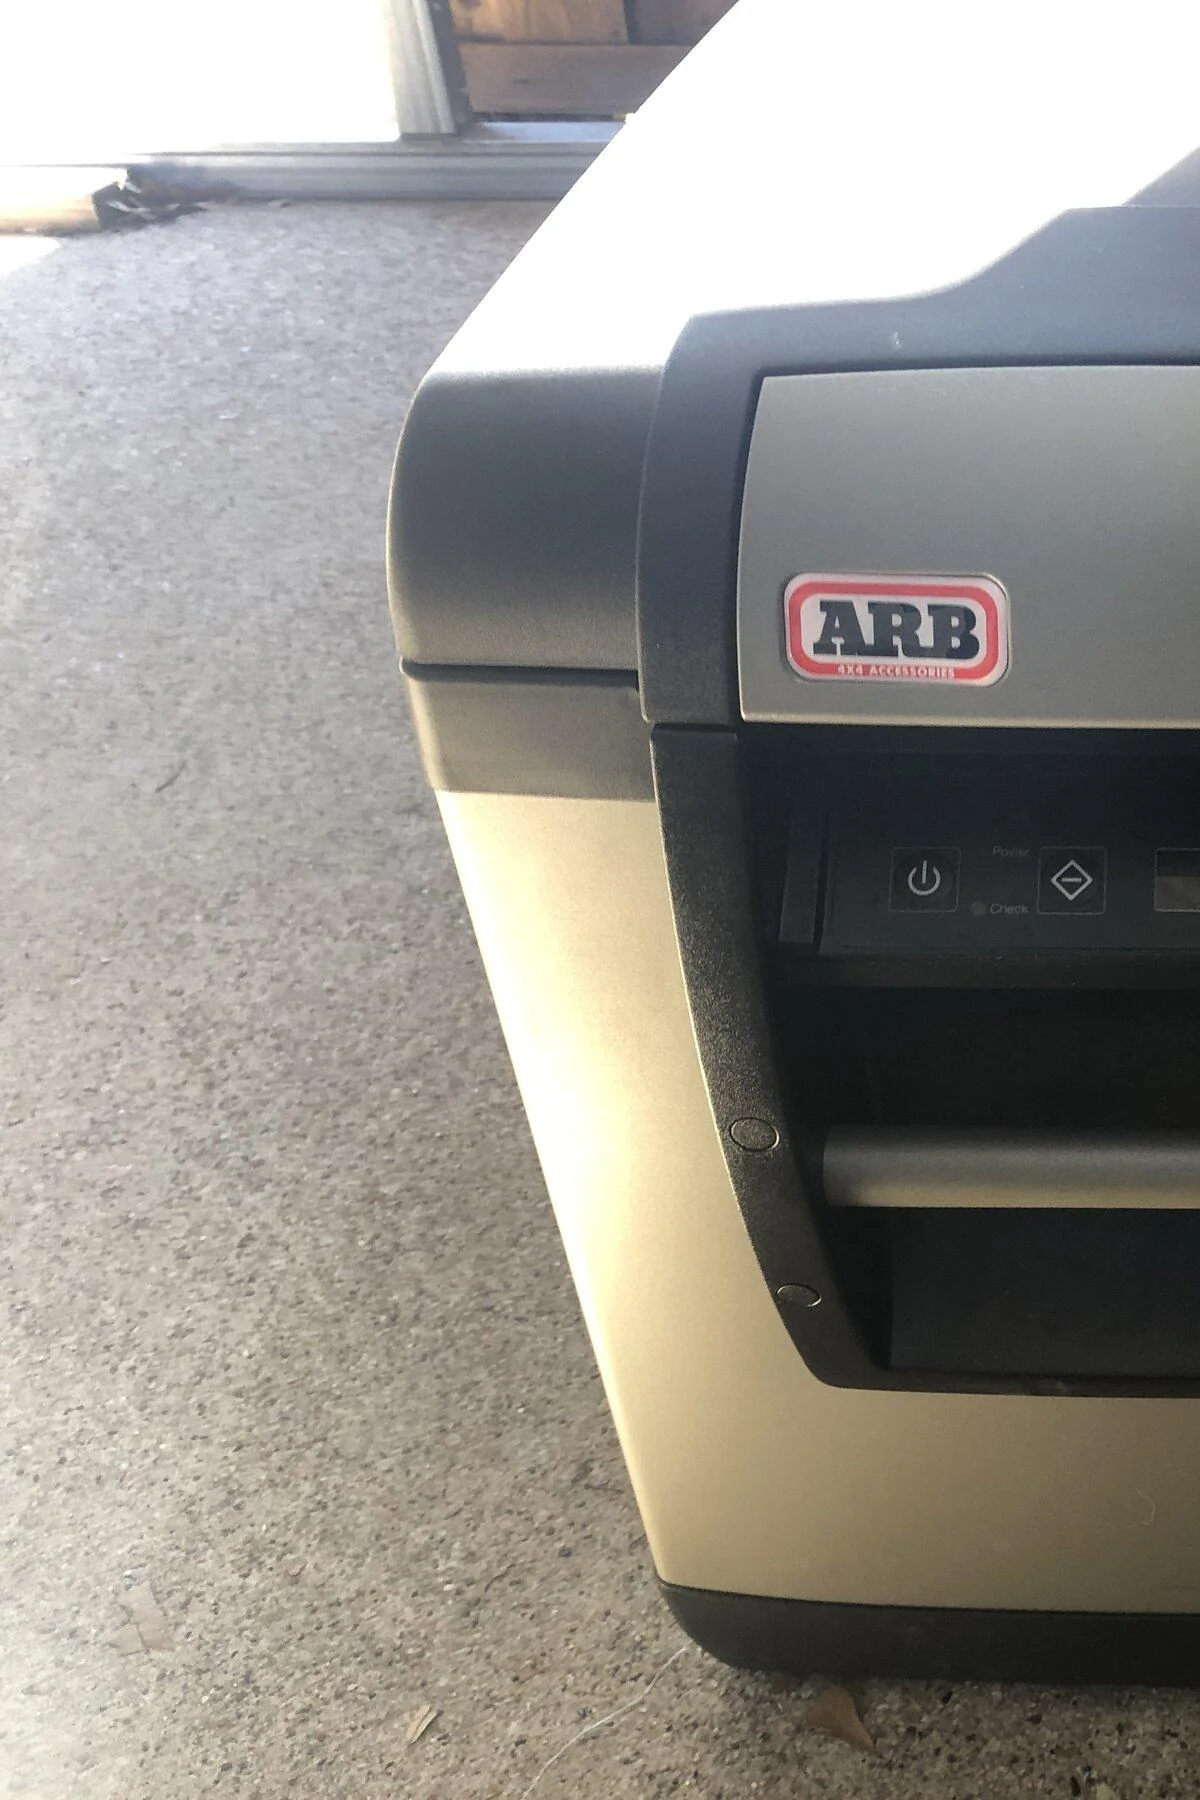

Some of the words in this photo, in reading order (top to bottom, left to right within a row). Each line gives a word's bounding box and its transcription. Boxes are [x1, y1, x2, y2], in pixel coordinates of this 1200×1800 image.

[812, 599, 980, 660] ARB
[836, 664, 863, 676] 4X4
[869, 664, 956, 679] ACCESSORIES
[992, 845, 1032, 858] Power
[989, 903, 1029, 915] Check
